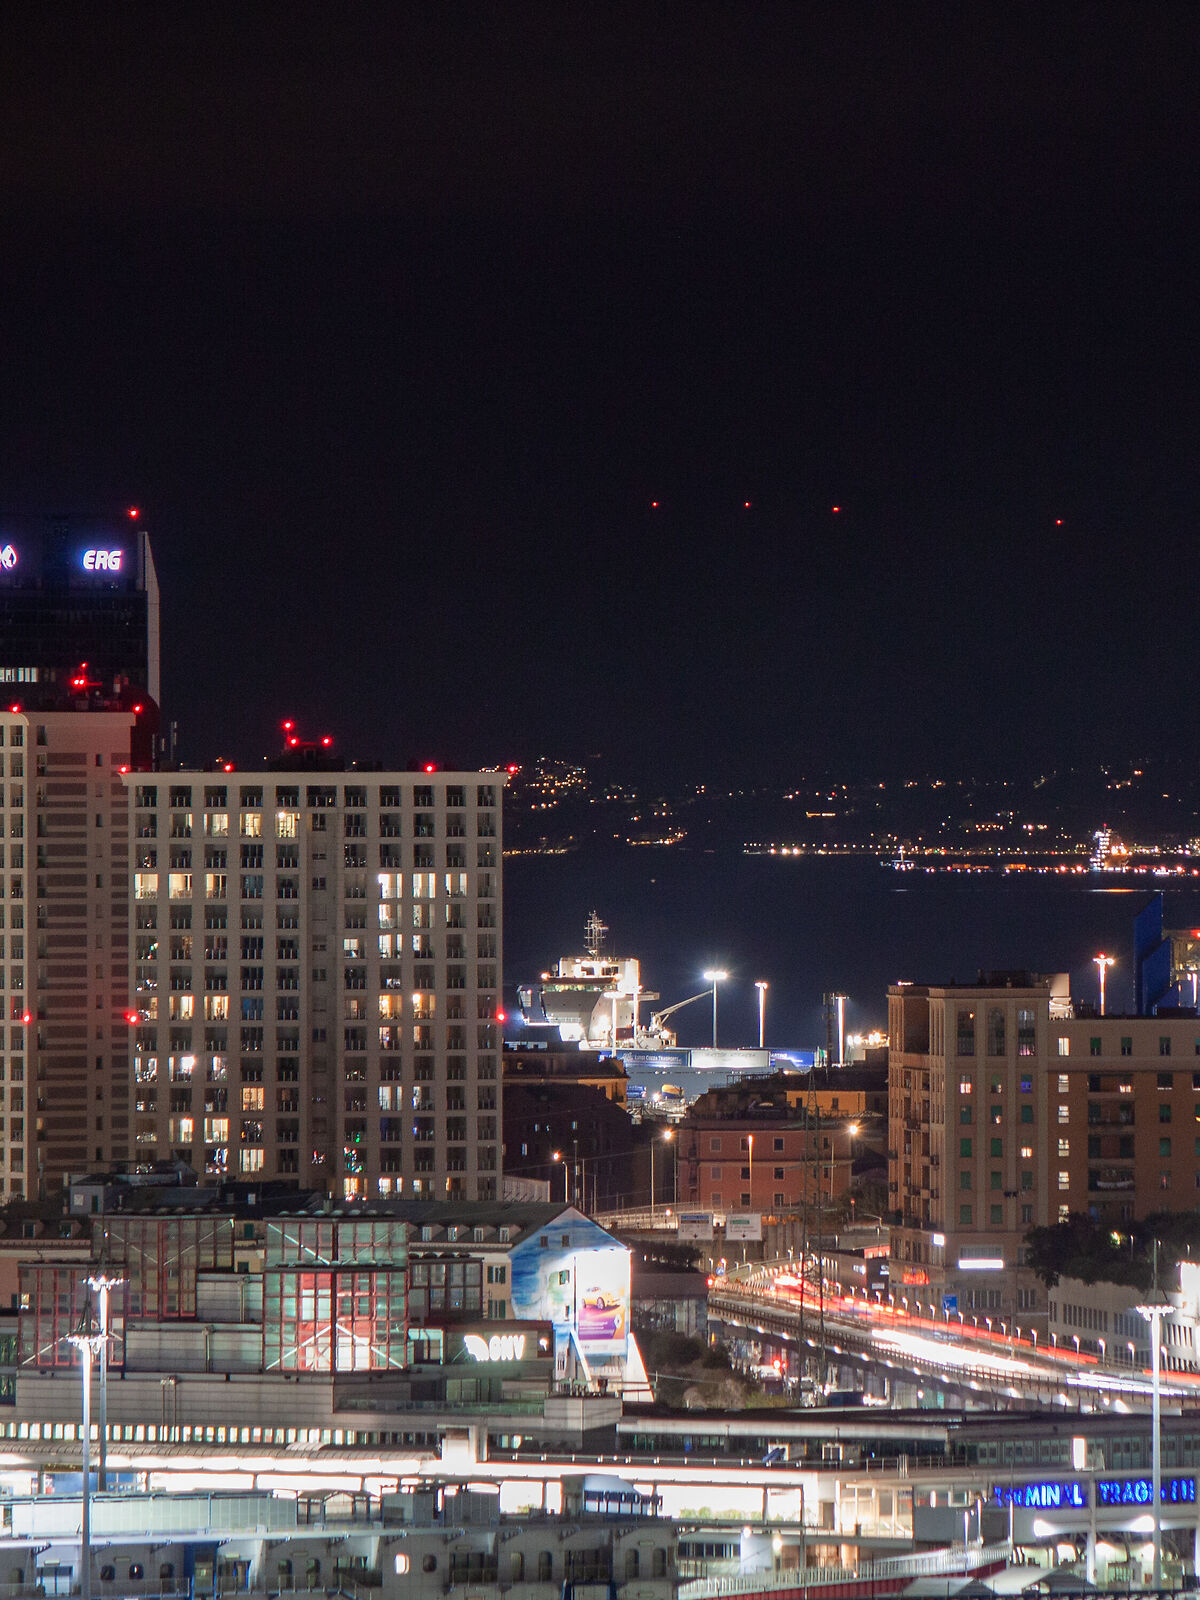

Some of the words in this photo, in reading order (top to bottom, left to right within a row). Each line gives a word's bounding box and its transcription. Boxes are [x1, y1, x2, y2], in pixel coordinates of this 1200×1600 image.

[83, 550, 122, 570] ERG
[994, 1482, 1083, 1507] TMINL
[1099, 1480, 1195, 1504] TRAGTTI
